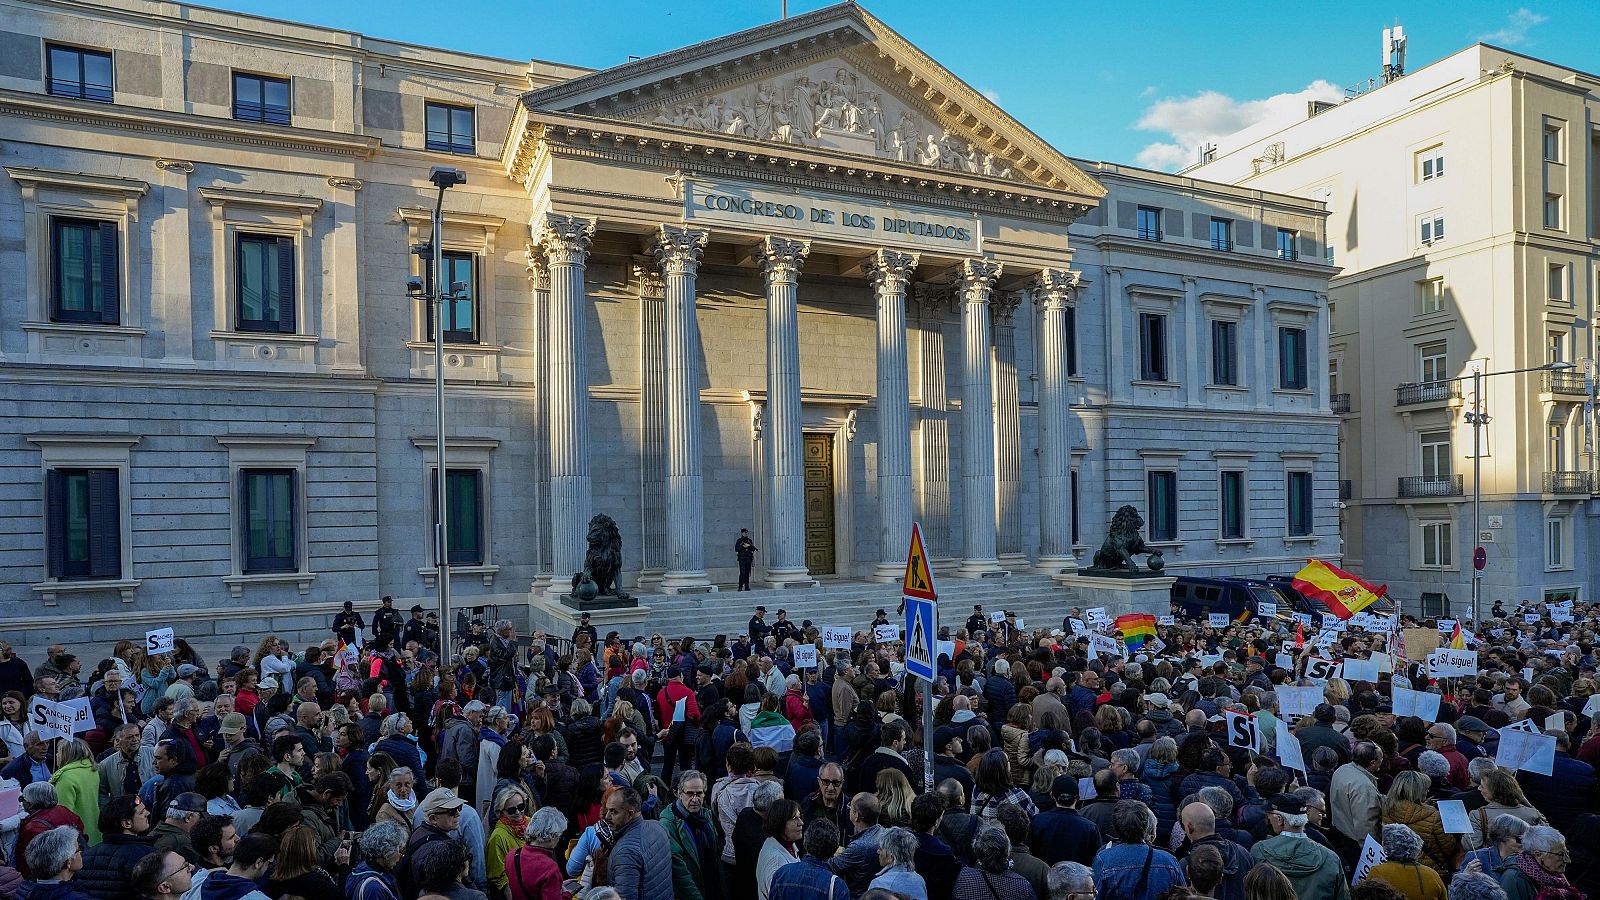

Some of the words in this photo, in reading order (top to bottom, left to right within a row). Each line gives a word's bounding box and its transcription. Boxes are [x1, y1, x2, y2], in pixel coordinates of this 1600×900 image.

[704, 194, 797, 219] CONGRESO
[810, 207, 830, 224] DE
[841, 211, 872, 229] LOS
[882, 216, 966, 241] DIPUTADOS
[1450, 655, 1475, 668] sigue!
